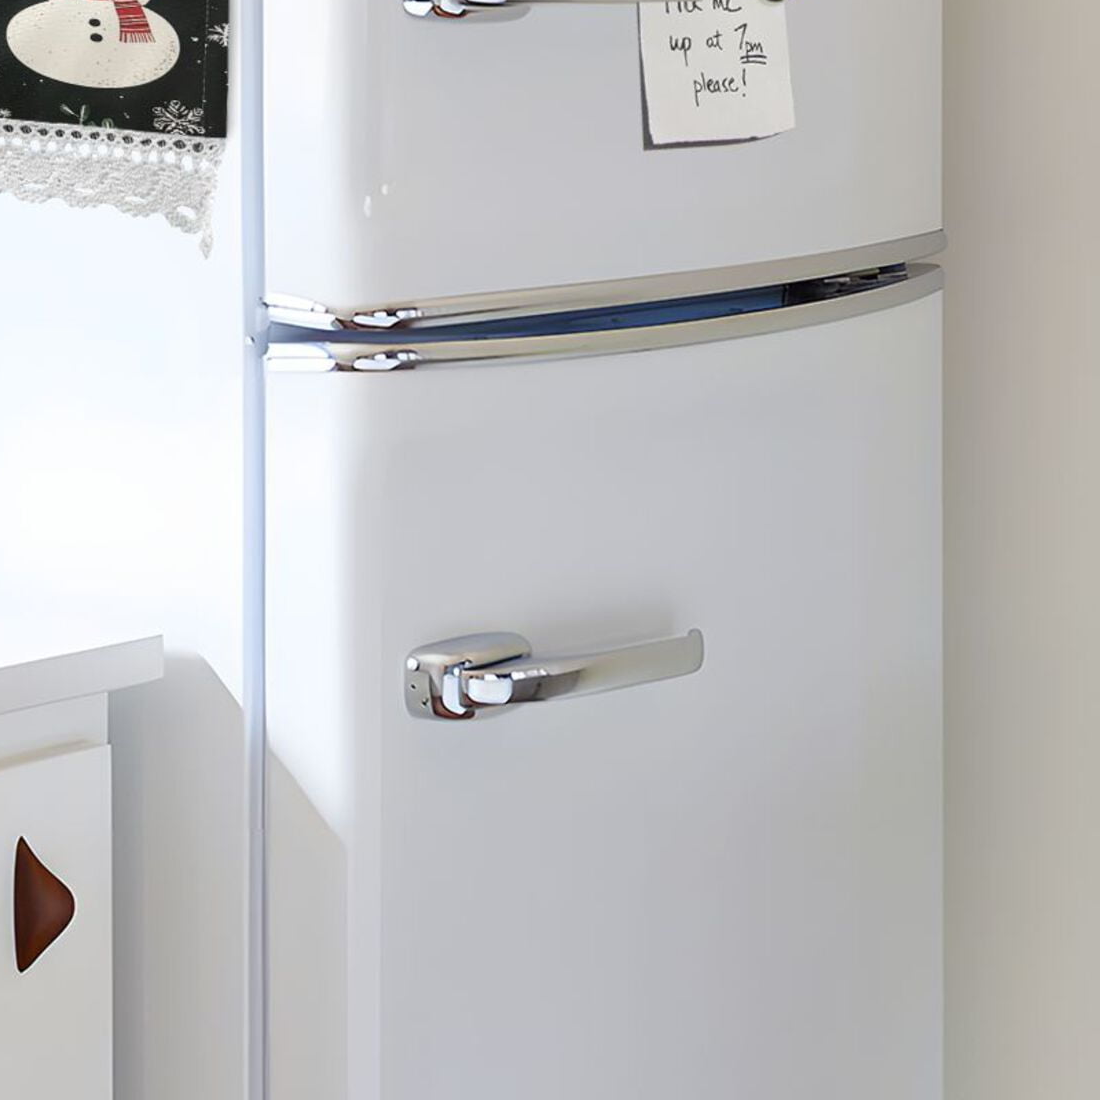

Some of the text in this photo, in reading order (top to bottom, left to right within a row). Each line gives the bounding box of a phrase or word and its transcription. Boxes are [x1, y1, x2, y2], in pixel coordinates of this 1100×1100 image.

[669, 34, 692, 67] up
[705, 30, 723, 51] at
[693, 68, 747, 107] please!
